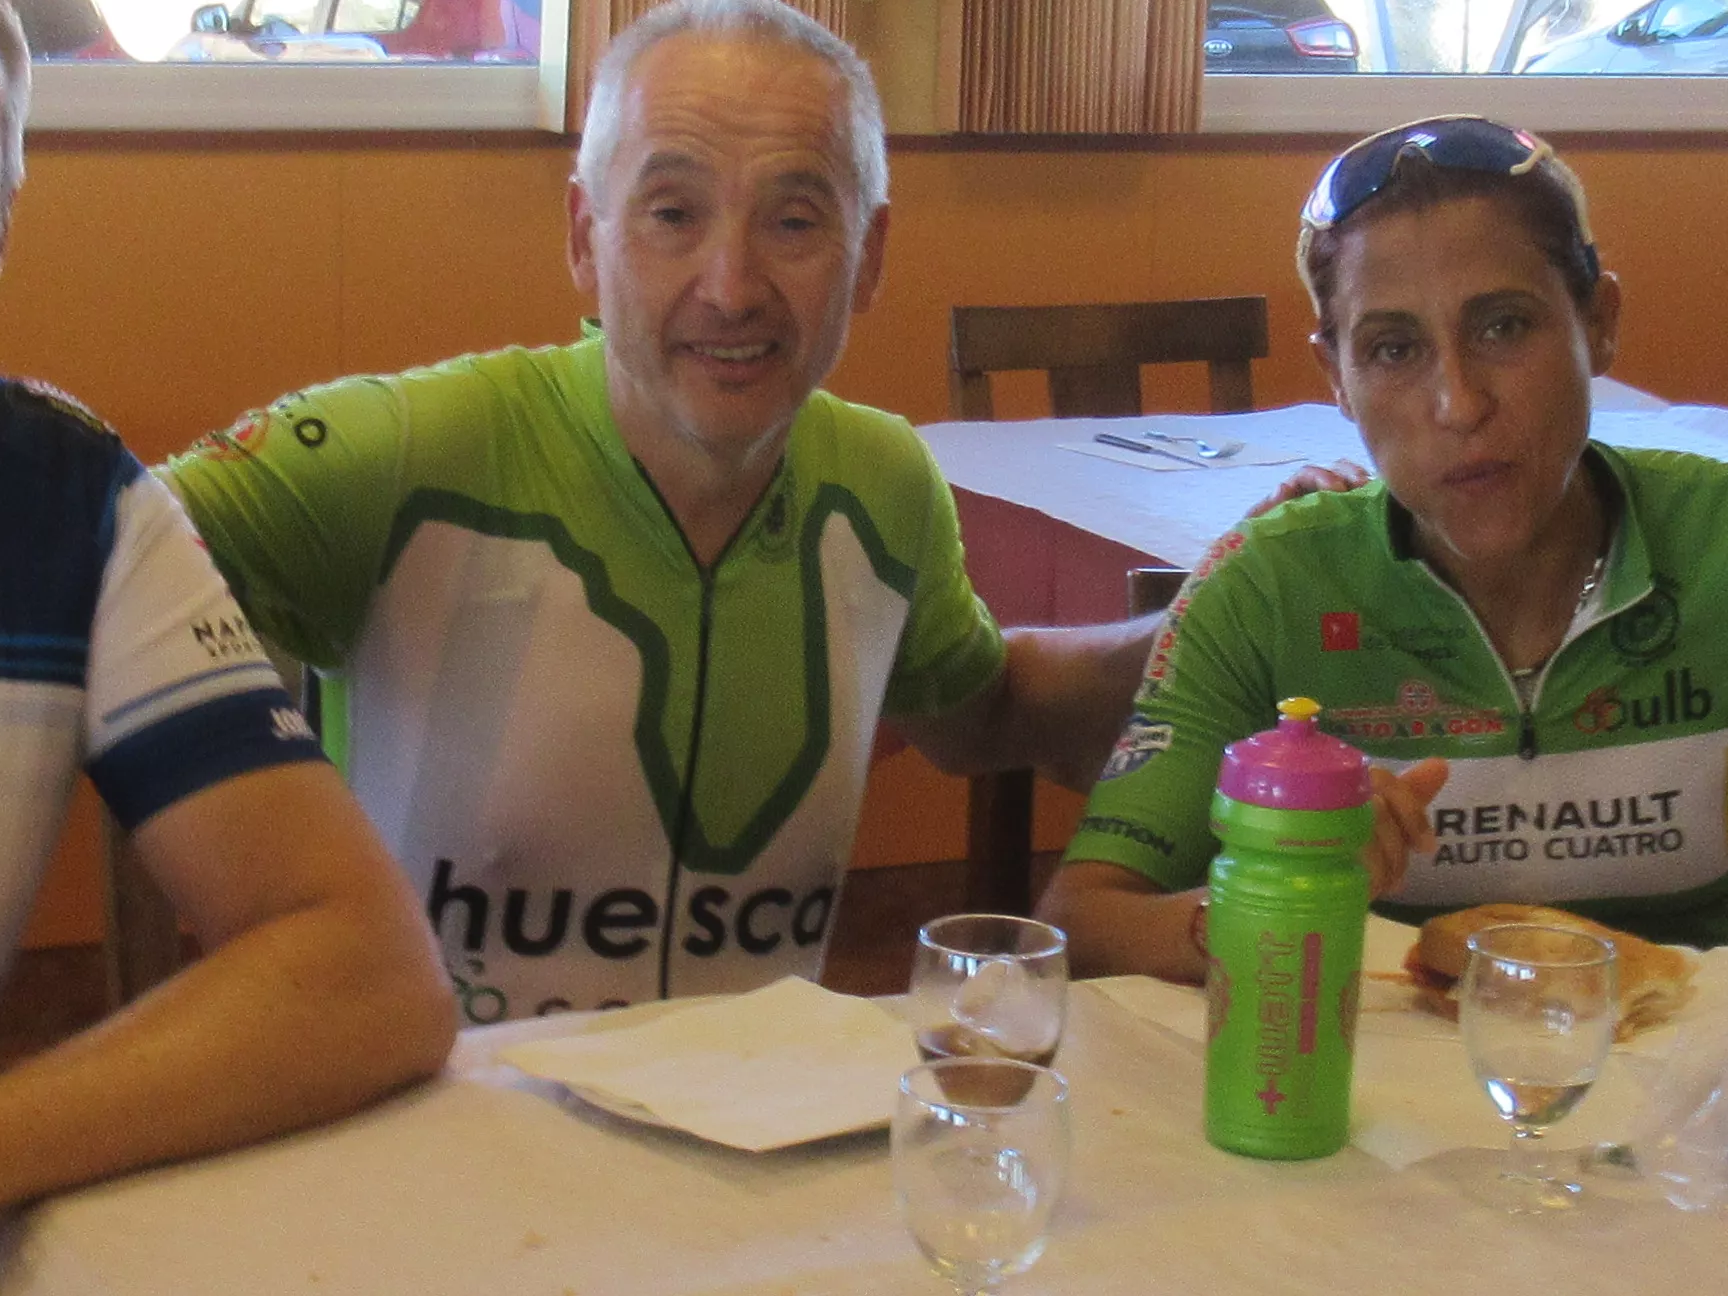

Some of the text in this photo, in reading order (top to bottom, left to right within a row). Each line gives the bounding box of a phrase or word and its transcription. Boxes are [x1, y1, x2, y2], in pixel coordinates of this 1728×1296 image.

[1434, 788, 1682, 838] RENAULT
[1431, 827, 1684, 867] AUTO CUATRO
[427, 857, 836, 960] huesca
